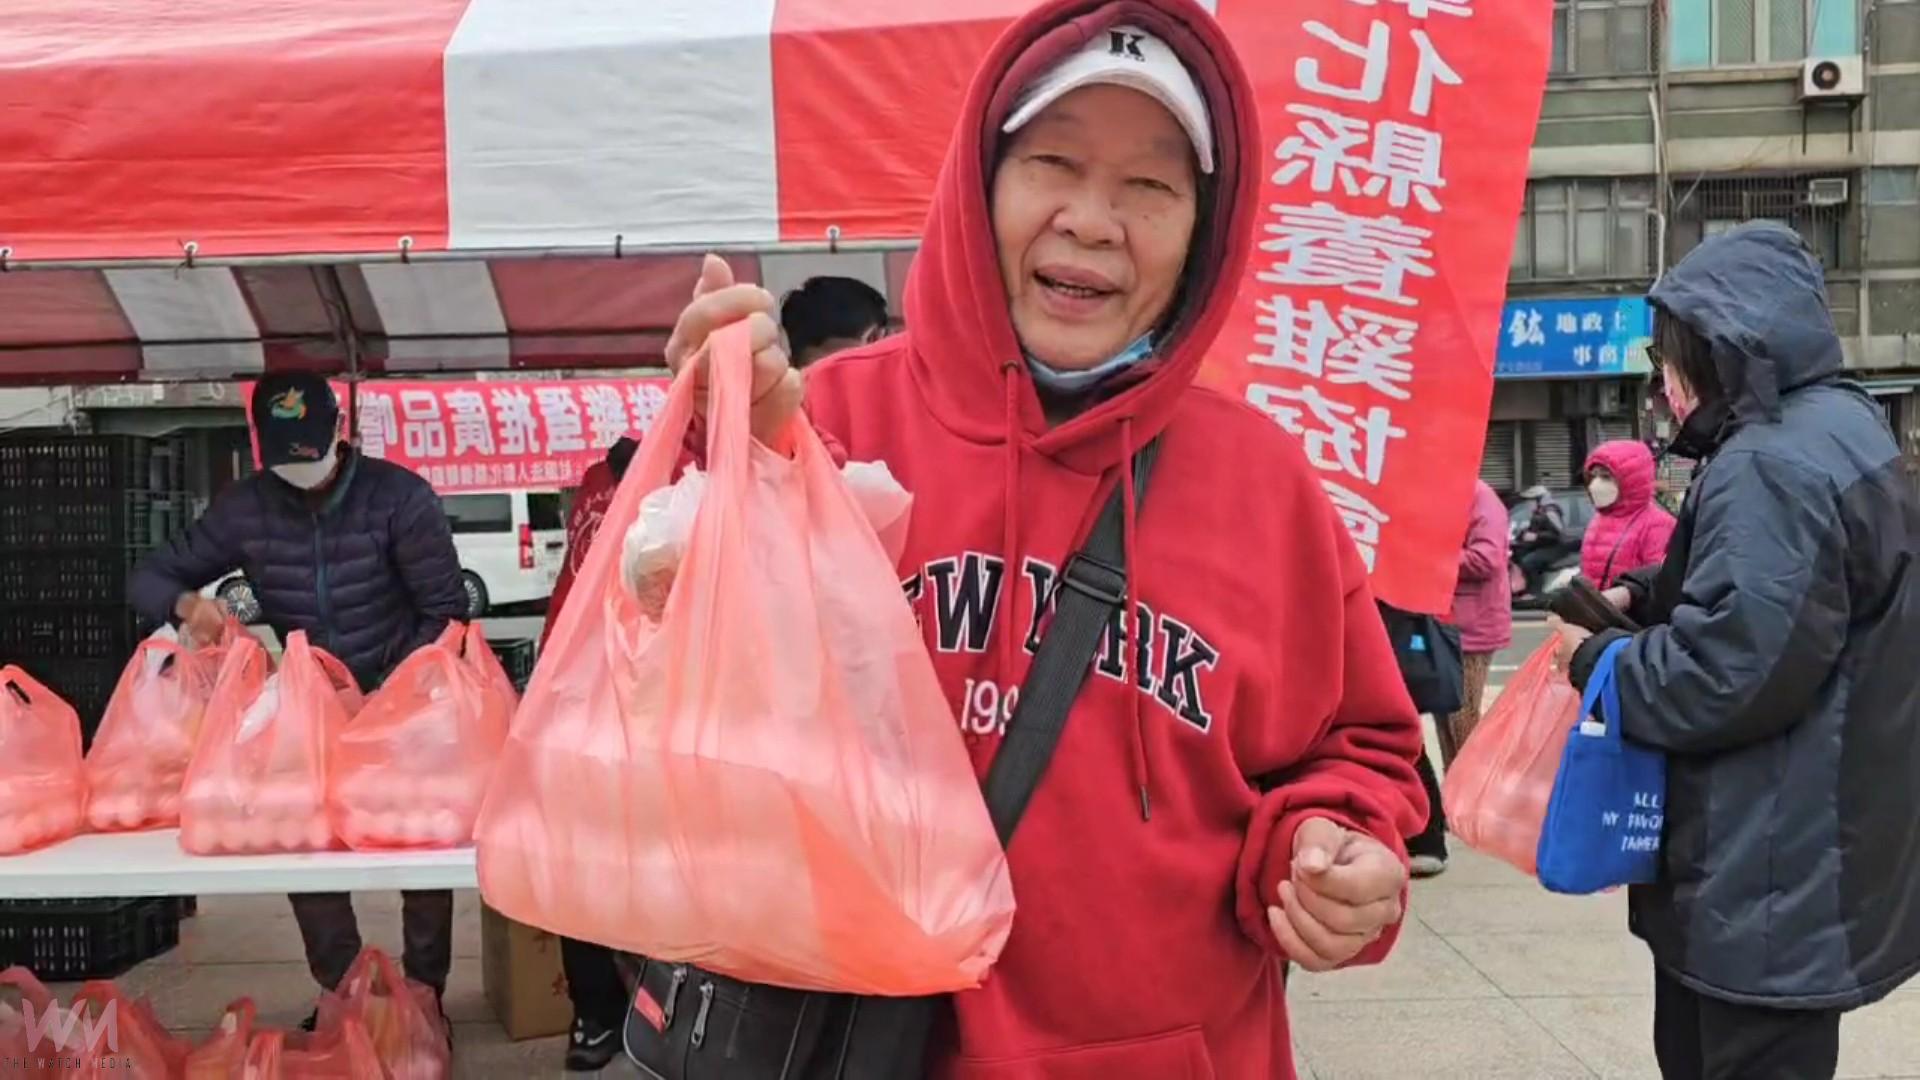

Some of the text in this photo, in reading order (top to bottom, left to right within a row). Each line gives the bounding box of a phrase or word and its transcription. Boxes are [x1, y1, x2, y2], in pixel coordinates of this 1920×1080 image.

[1108, 30, 1146, 62] K
[1022, 556, 1219, 734] YRK
[1633, 791, 1660, 809] ALL
